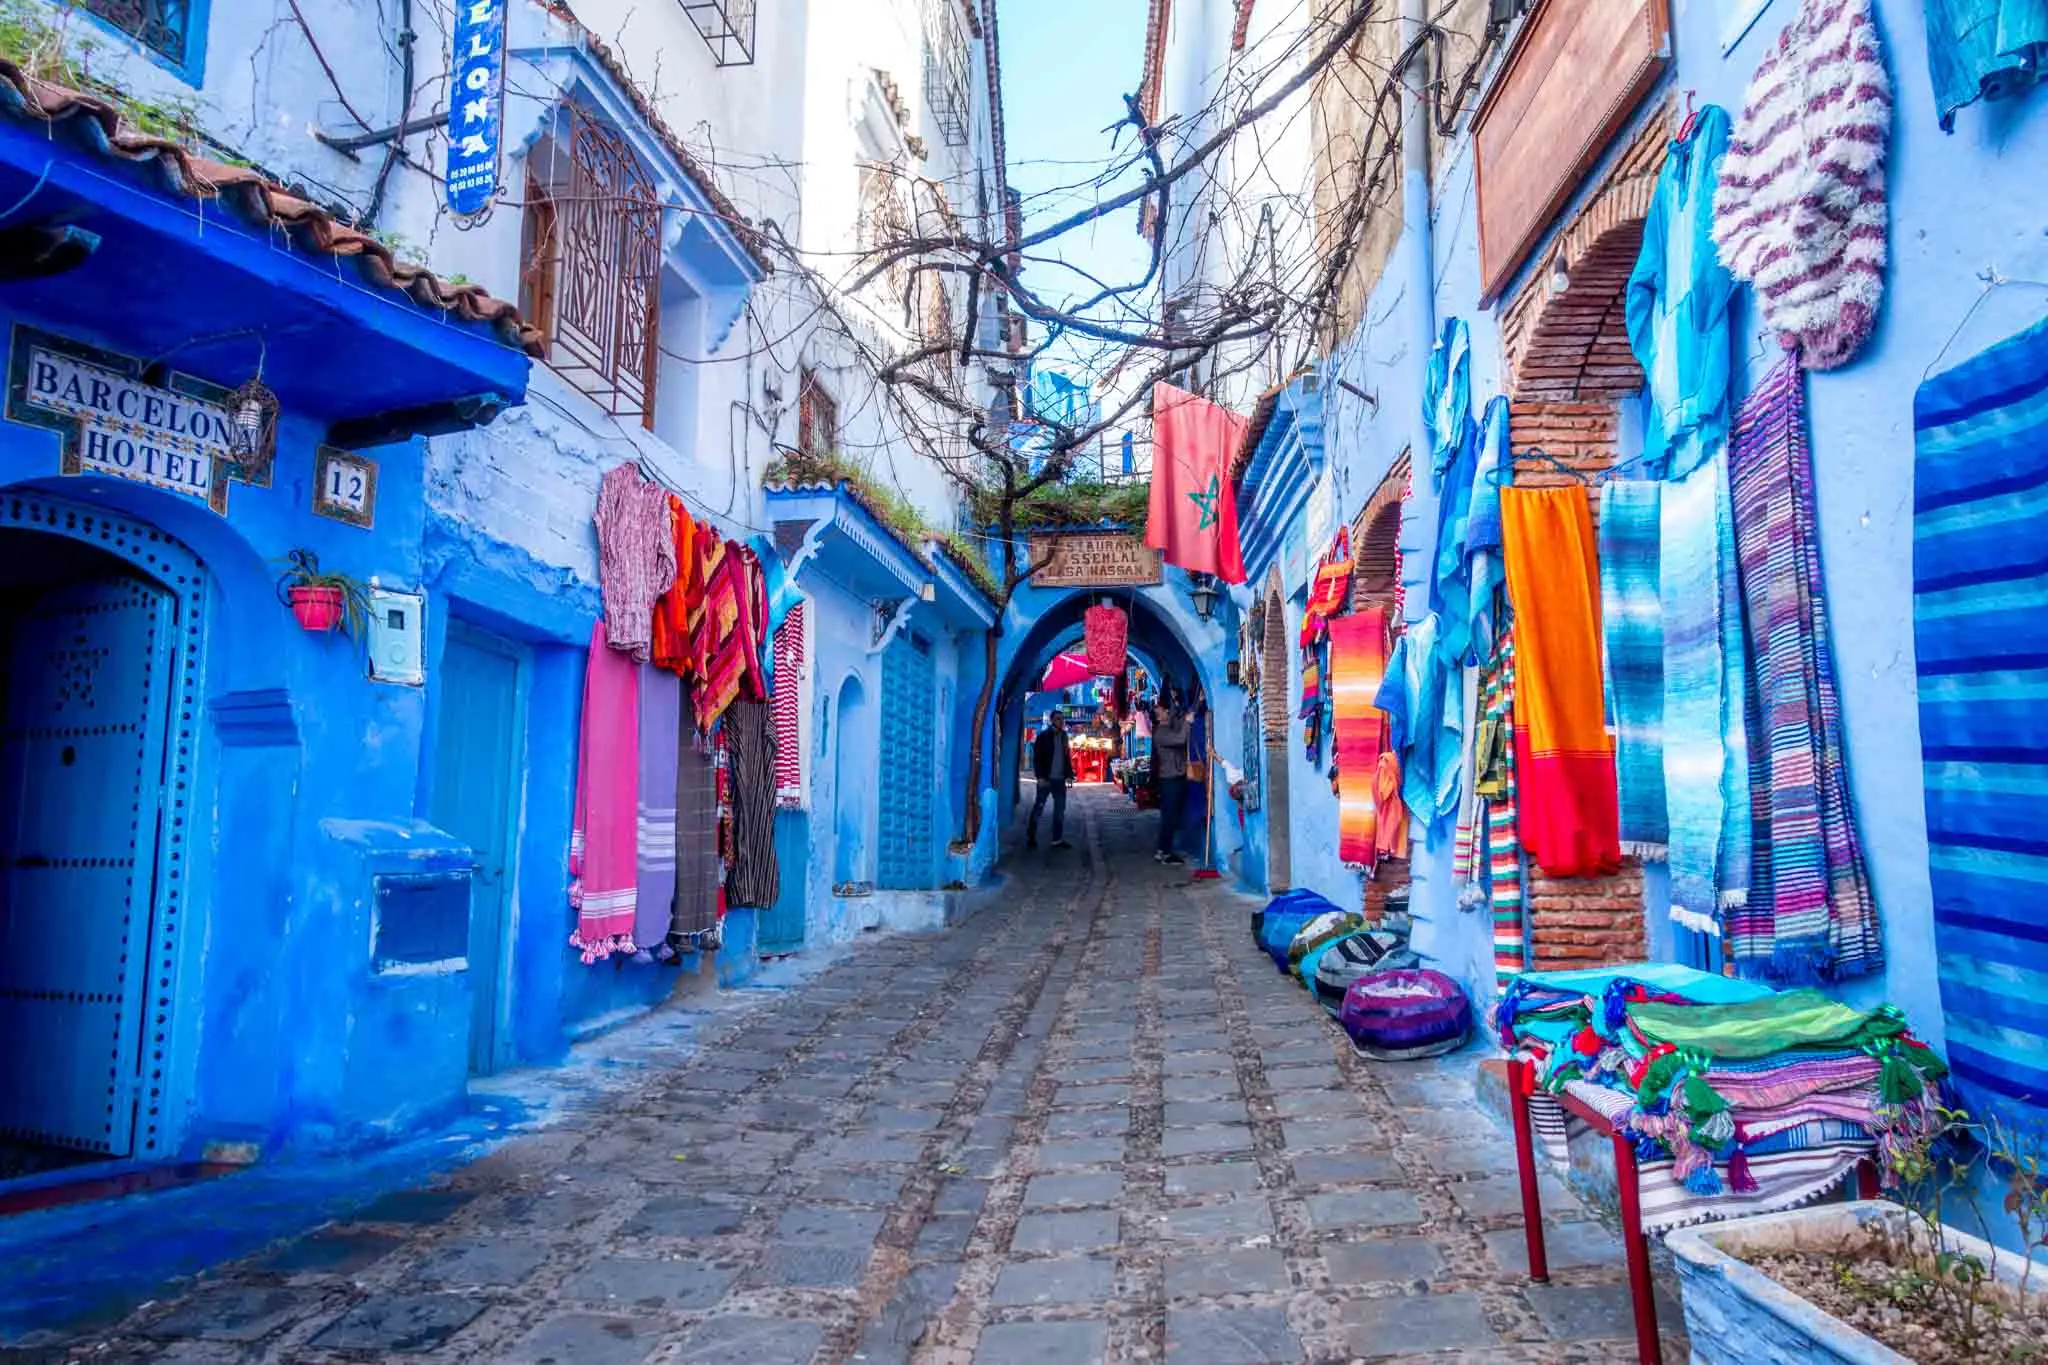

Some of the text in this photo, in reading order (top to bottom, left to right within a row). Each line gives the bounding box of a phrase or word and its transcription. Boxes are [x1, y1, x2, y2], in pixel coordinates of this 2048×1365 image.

[84, 430, 208, 489] HOTEL
[331, 471, 362, 502] 12
[1090, 564, 1143, 576] HASSAN
